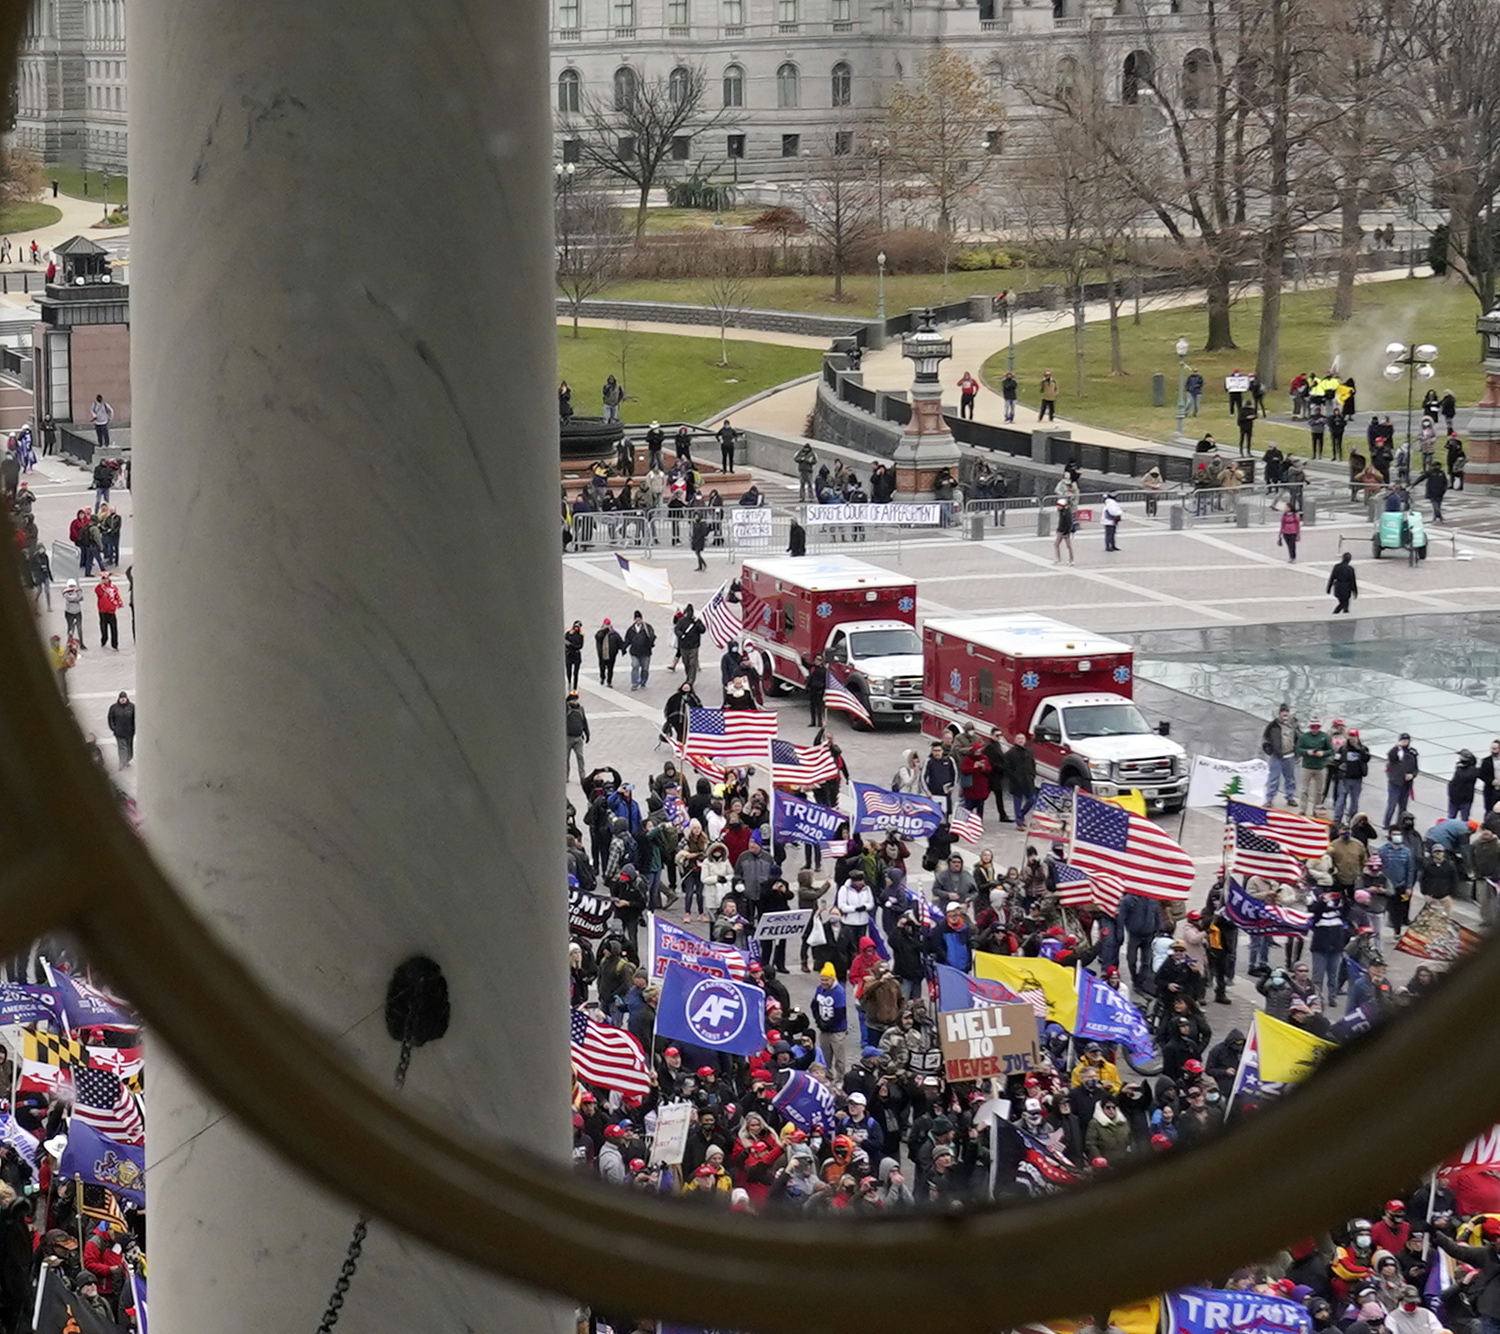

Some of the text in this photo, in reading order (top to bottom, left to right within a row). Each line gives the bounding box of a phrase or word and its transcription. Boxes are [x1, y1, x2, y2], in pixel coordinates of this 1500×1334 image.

[843, 504, 869, 520] COURT
[877, 815, 924, 829] OHIO
[760, 923, 805, 936] FREEDOM
[657, 956, 725, 978] TMP
[1, 1004, 38, 1014] AMERICA
[692, 994, 740, 1028] AF
[946, 1008, 1011, 1042] HELL
[969, 1038, 994, 1059] NO
[946, 1056, 1001, 1081] NEVER
